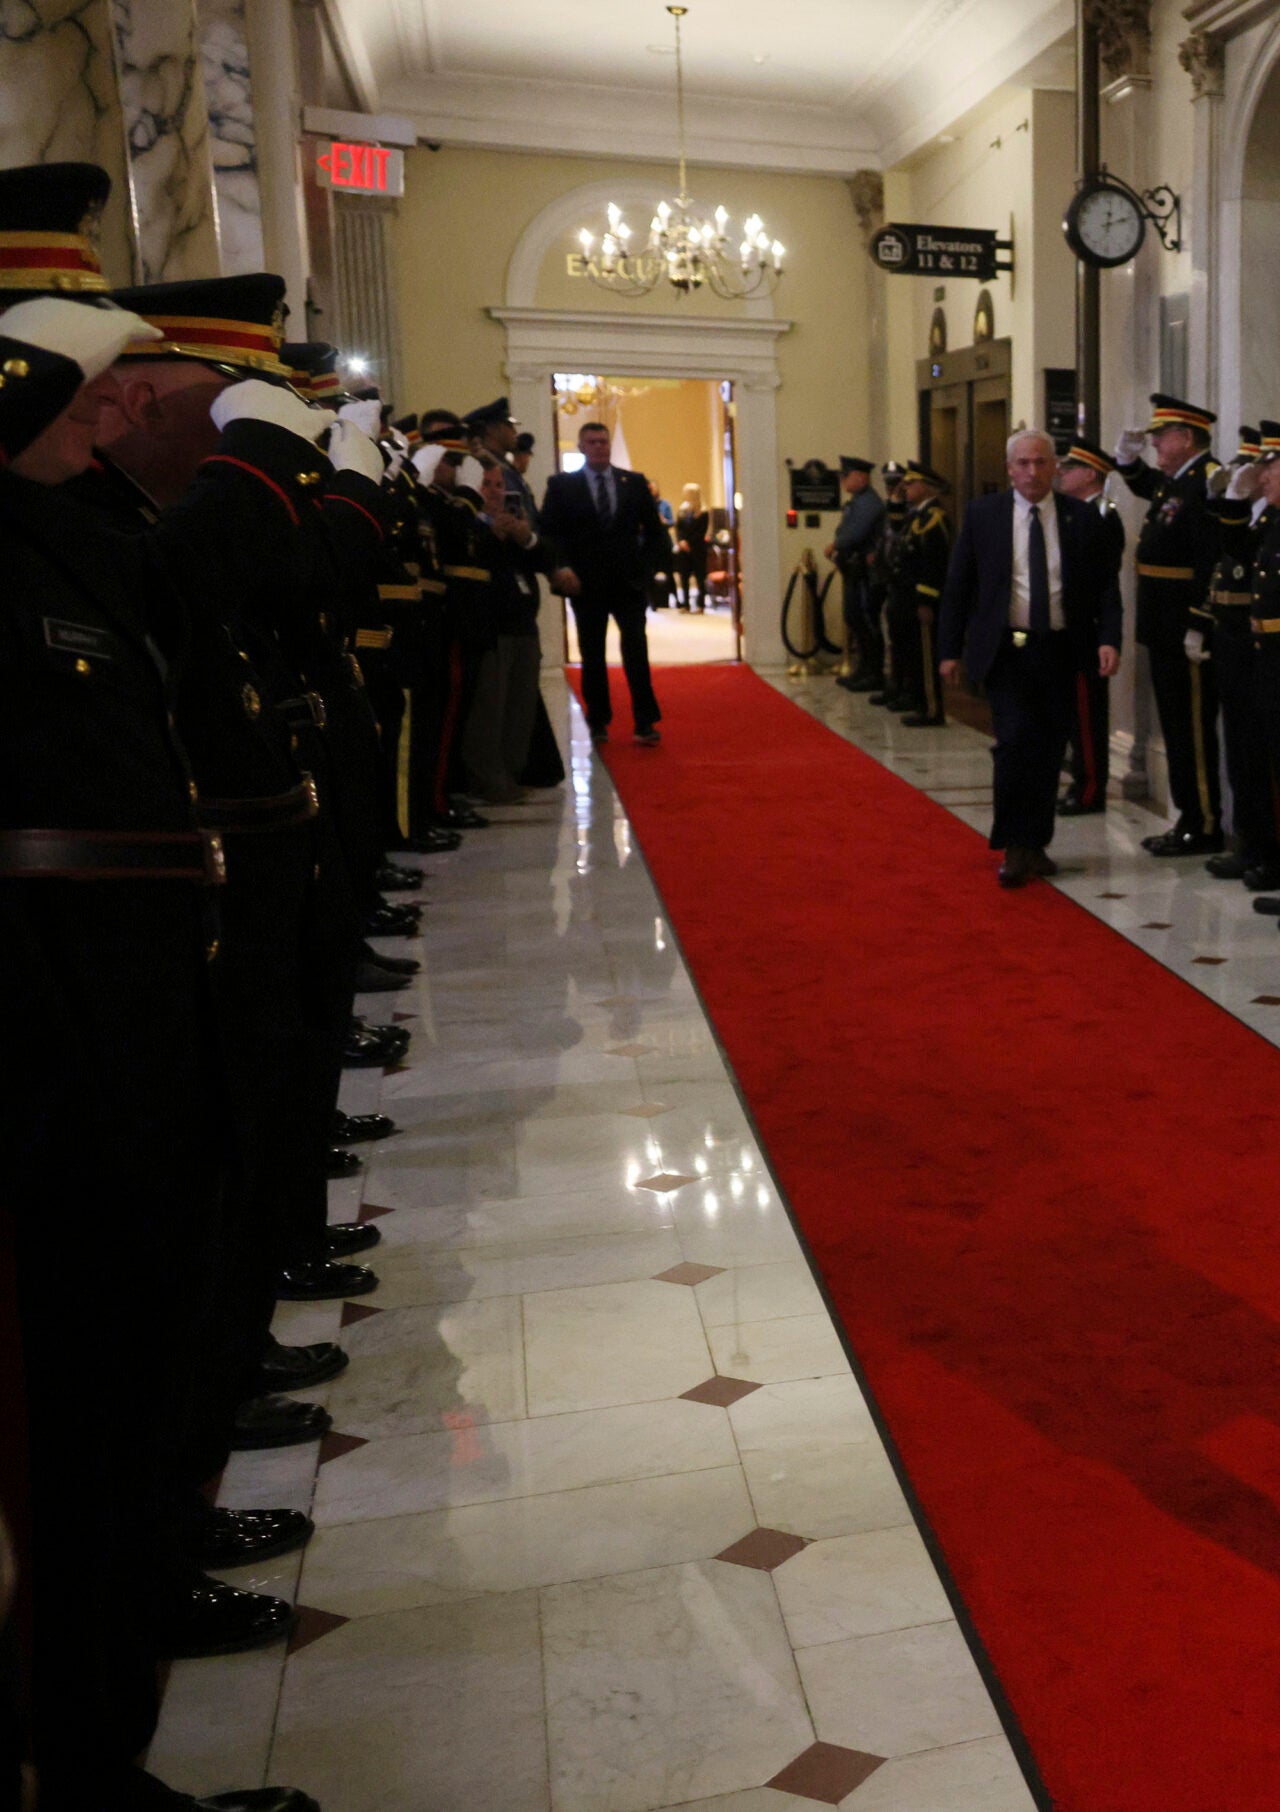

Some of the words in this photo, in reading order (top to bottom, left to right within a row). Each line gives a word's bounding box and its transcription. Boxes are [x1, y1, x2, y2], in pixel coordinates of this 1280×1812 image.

[331, 141, 391, 191] EXIT
[916, 234, 983, 253] Elevators
[918, 253, 934, 268] 11
[938, 253, 954, 269] &
[960, 255, 978, 270] 12
